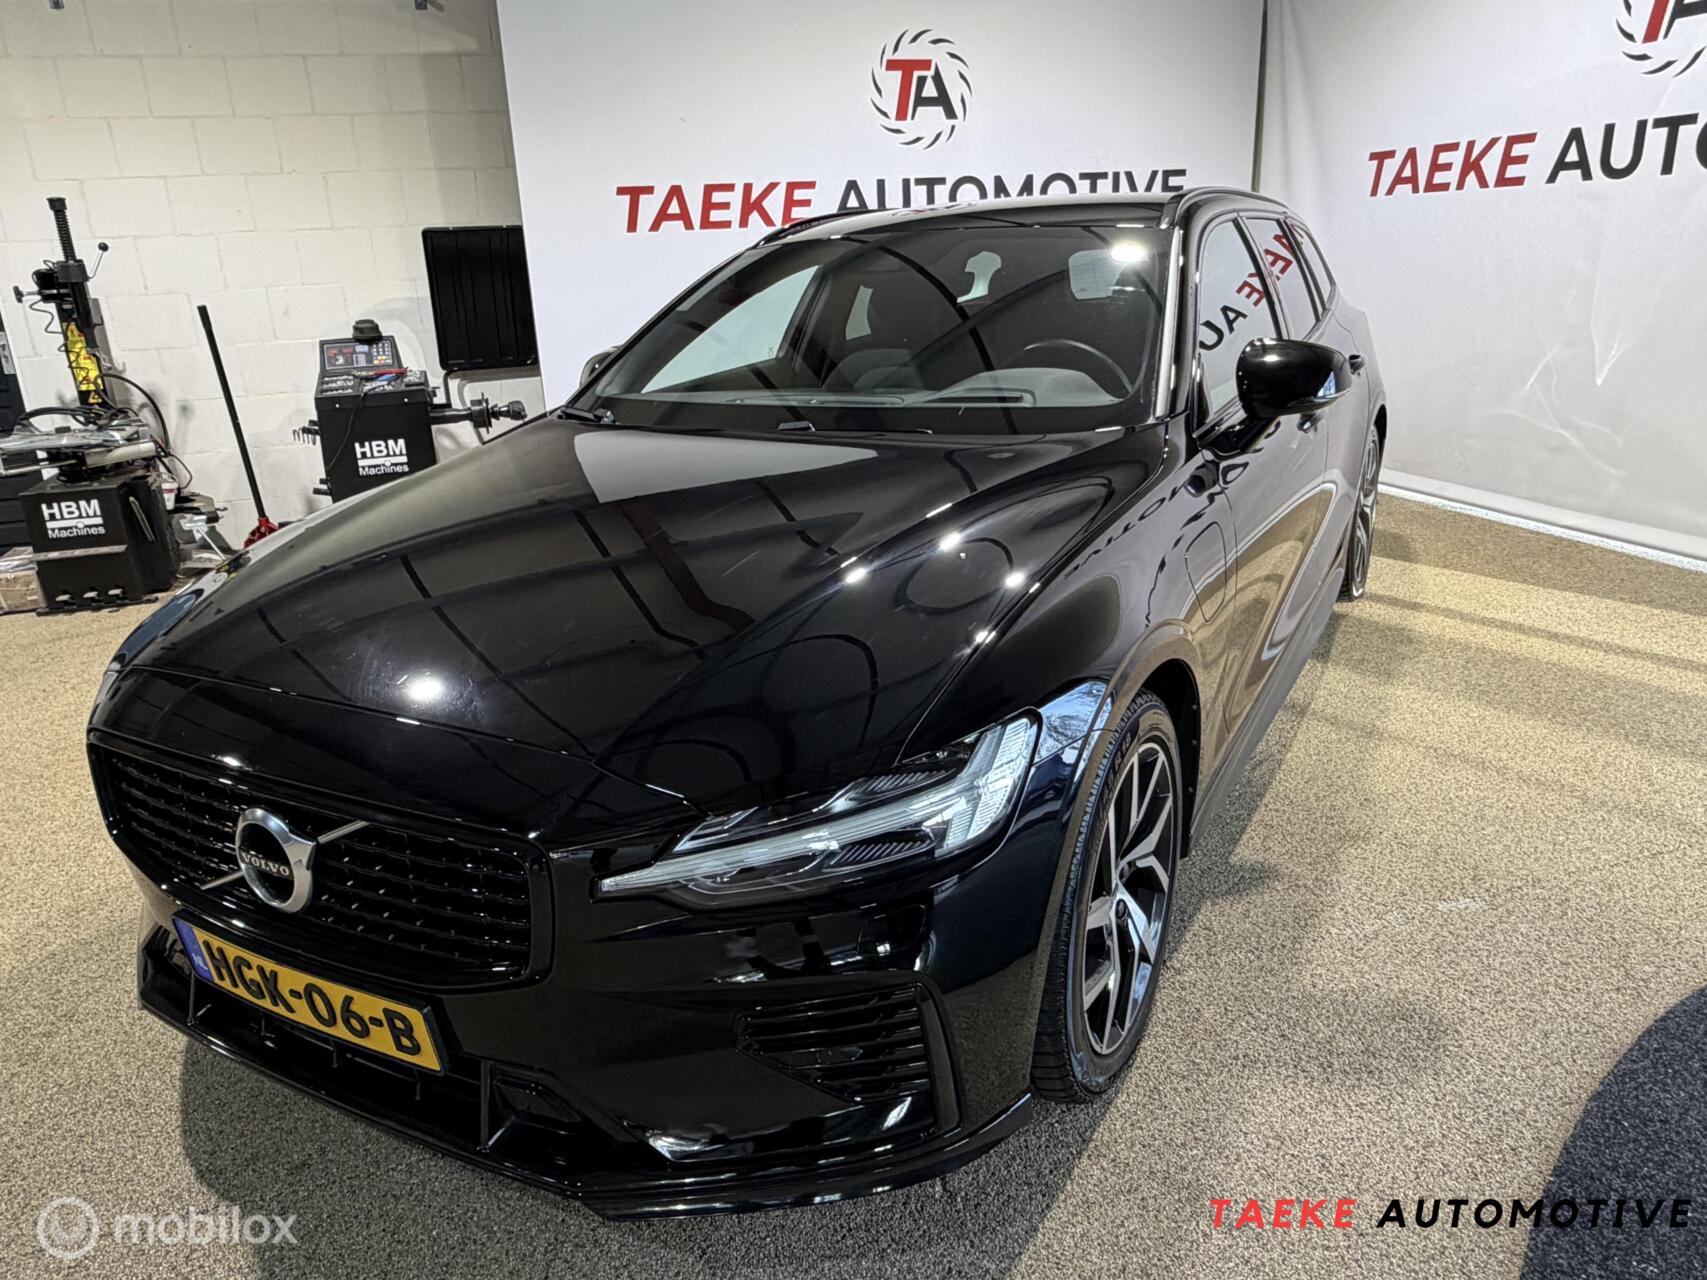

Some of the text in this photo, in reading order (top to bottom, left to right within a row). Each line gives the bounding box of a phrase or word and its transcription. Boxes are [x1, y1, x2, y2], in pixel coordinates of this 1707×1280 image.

[885, 58, 958, 121] TA
[1368, 113, 1707, 197] TAEKE AUT
[616, 181, 817, 233] TAEKE
[354, 438, 407, 459] HBM
[358, 464, 409, 477] Machines
[41, 499, 101, 521] HBM
[48, 526, 105, 540] Machines
[240, 852, 291, 877] VOLVO
[202, 939, 422, 1056] HGK-06-B
